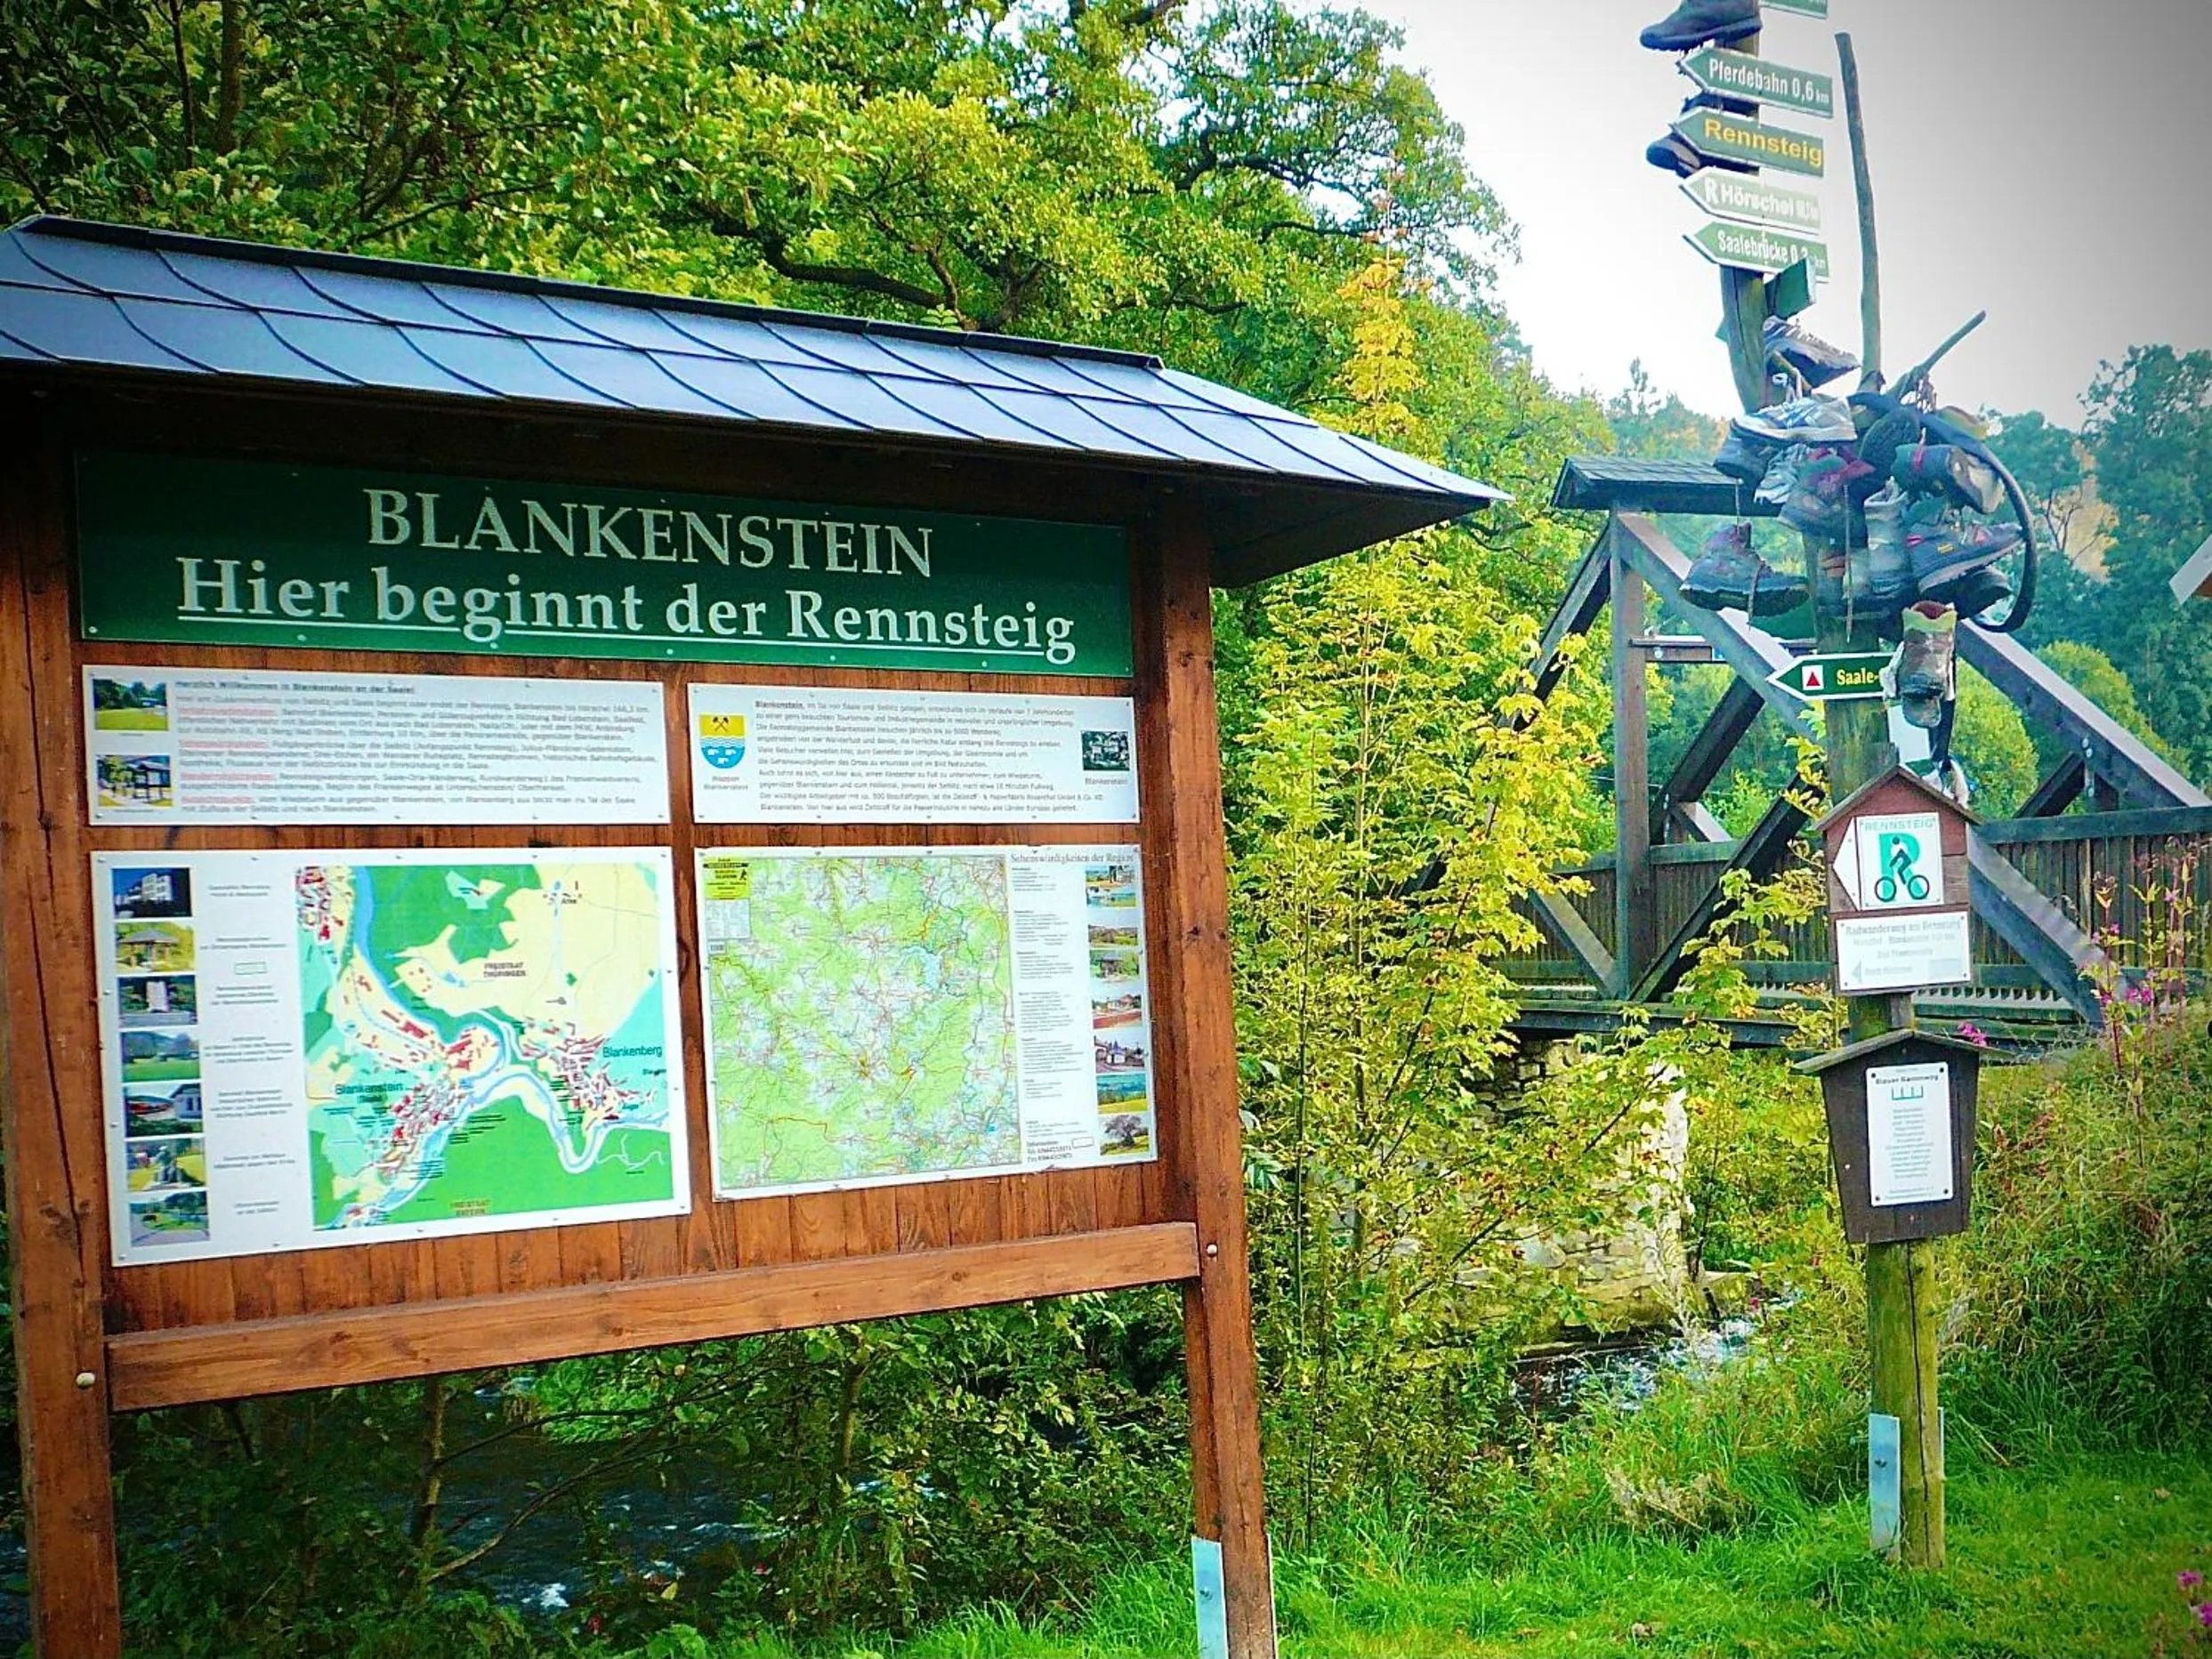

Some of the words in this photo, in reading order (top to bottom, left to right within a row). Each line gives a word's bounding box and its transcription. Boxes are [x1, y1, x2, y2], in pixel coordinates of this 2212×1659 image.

[1709, 58, 1788, 95] Pferdebahn
[1792, 77, 1814, 102] 0,6
[1705, 118, 1823, 168] Rennsteig
[1717, 230, 1788, 264] Saalebrücke
[363, 487, 933, 578] BLANKENSTEIN
[175, 557, 350, 620] Hier
[371, 567, 643, 643] beginnt
[666, 583, 768, 637] der
[784, 589, 1077, 664] Rennsteig
[602, 1045, 663, 1059] Blankenberg
